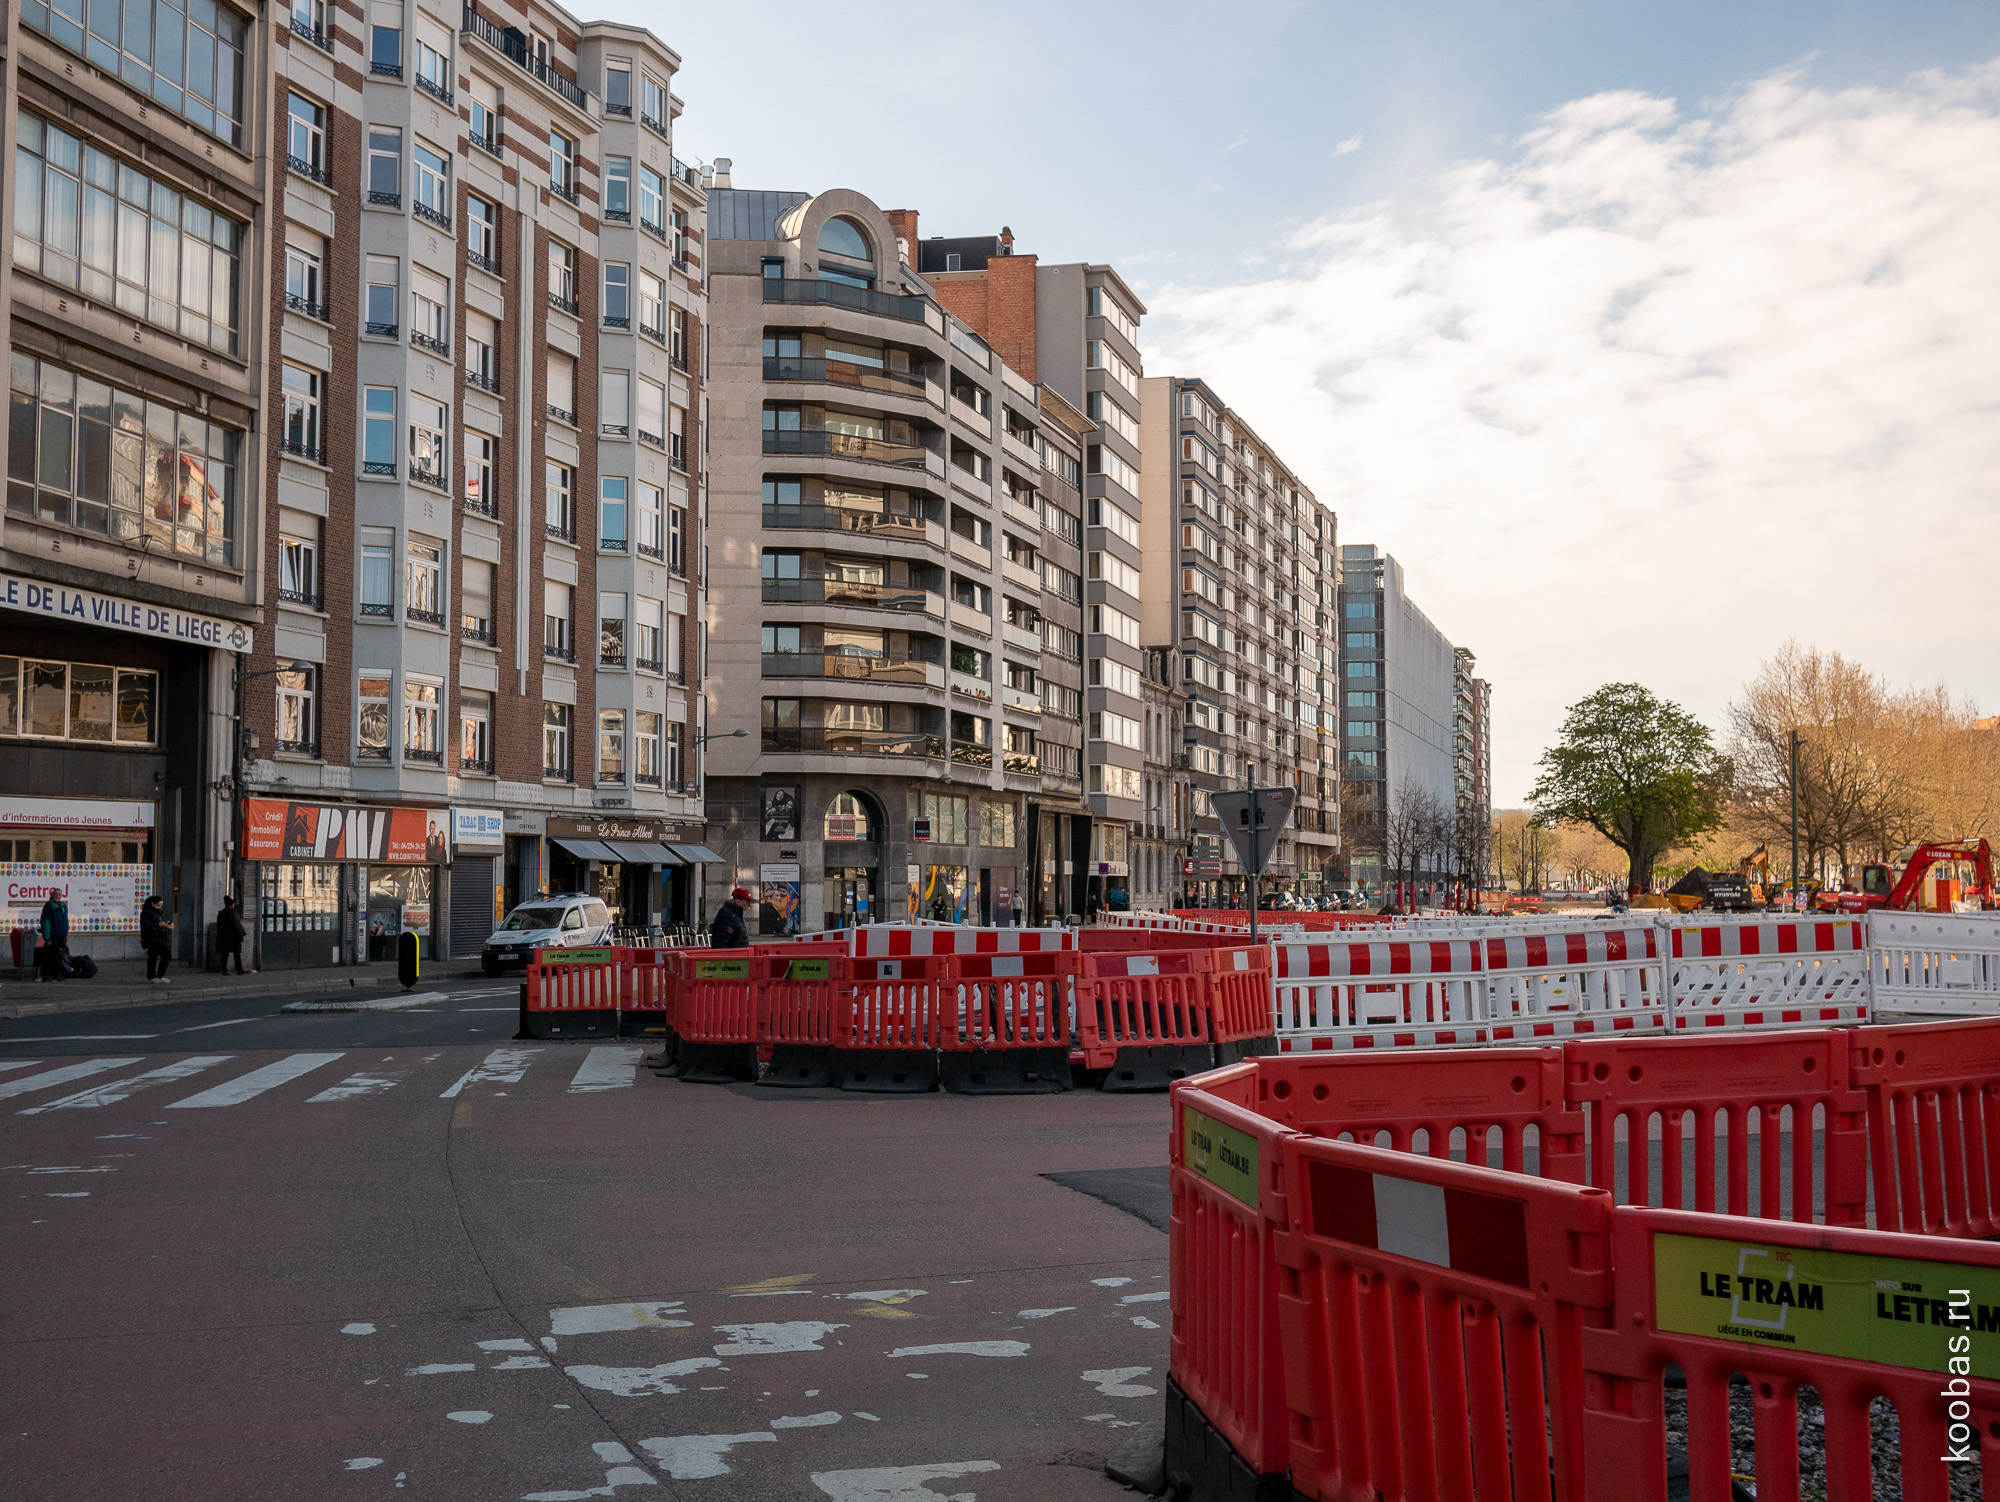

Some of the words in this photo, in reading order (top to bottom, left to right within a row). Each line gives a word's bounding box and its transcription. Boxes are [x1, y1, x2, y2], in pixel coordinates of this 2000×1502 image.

[27, 583, 53, 611] DE
[61, 590, 85, 618] LA
[92, 597, 141, 628] VILLE
[147, 608, 170, 634] DE
[176, 614, 222, 643] LIEGE
[2, 812, 62, 824] d'information
[63, 814, 80, 824] des
[81, 815, 112, 825] Jeunes
[265, 811, 283, 821] Crédit
[459, 815, 477, 828] TABAC
[486, 817, 502, 830] SHOP
[250, 824, 281, 834] Immobilier
[598, 822, 609, 837] Le
[610, 823, 631, 838] Prince
[631, 825, 654, 839] Albert
[249, 838, 279, 848] Assurance
[290, 846, 314, 857] CABINET
[1191, 1129, 1197, 1146] LE
[1197, 1132, 1212, 1155] TRAM
[1219, 1143, 1250, 1176] LETRAM.BE
[1775, 1250, 1792, 1263] TEC
[1700, 1271, 1731, 1299] LE
[1737, 1275, 1824, 1311] TRAM
[1875, 1279, 1901, 1291] INFO
[1901, 1281, 1922, 1293] SUR
[1717, 1324, 1740, 1337] LIÈGE
[1741, 1328, 1753, 1338] EN
[1754, 1330, 1796, 1344] COMMUN
